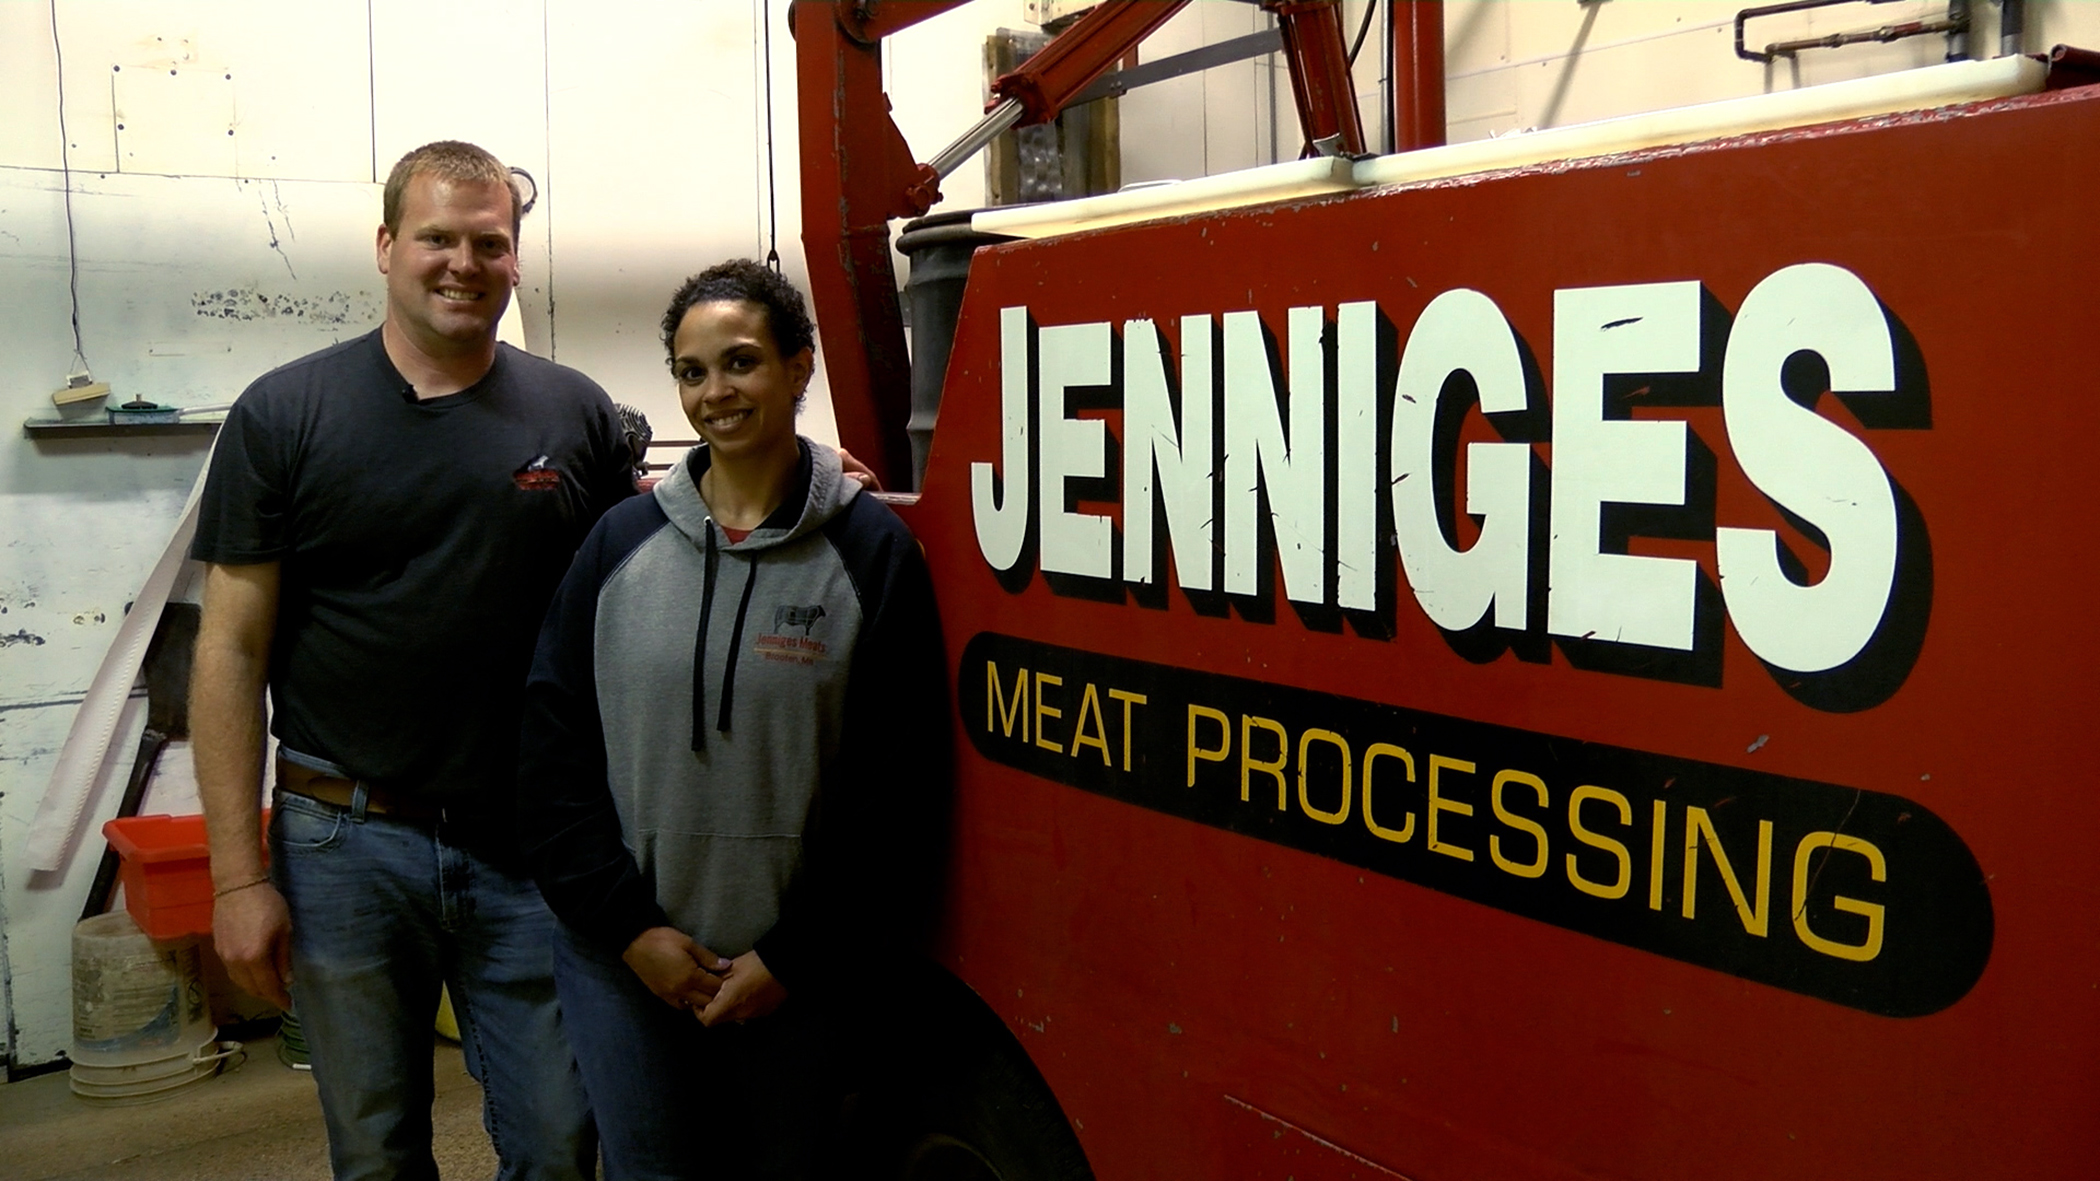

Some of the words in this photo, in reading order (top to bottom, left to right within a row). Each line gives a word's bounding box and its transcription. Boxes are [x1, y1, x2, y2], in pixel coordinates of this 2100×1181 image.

[971, 262, 1898, 673] JENNIGES
[756, 633, 797, 648] Jenniges
[799, 636, 826, 653] Meats
[986, 661, 1148, 773] MEAT
[1187, 704, 1888, 963] PROCESSING
